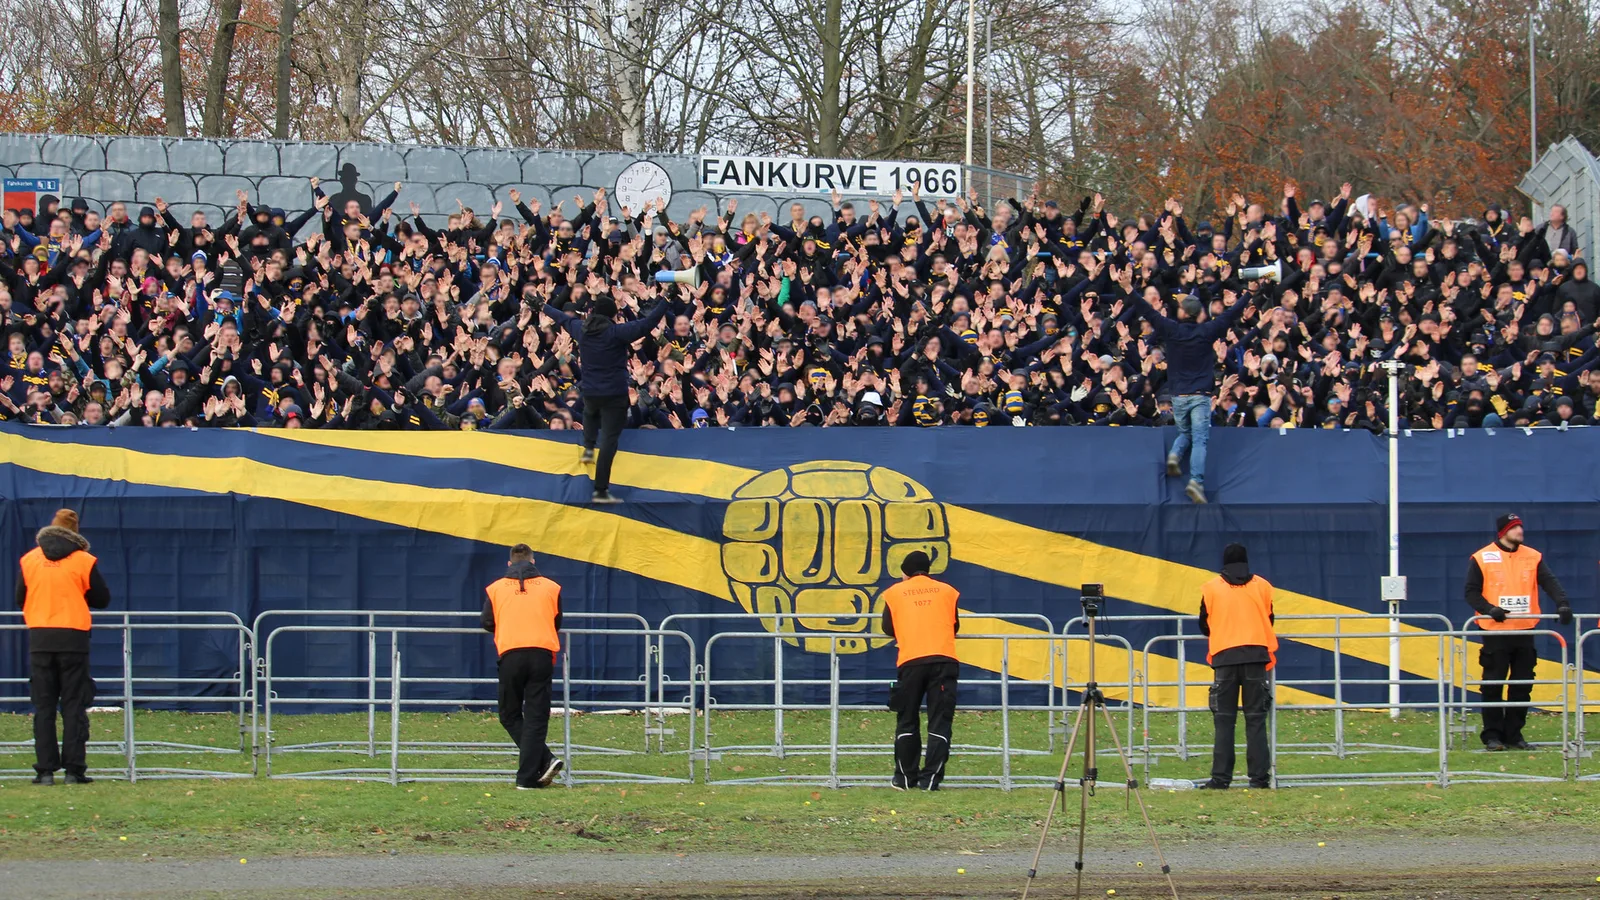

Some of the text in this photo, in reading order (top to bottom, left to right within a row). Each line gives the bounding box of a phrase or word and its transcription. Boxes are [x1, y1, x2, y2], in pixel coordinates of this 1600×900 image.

[702, 159, 957, 194] FANKURVE 1966
[903, 587, 940, 596] STEWARD
